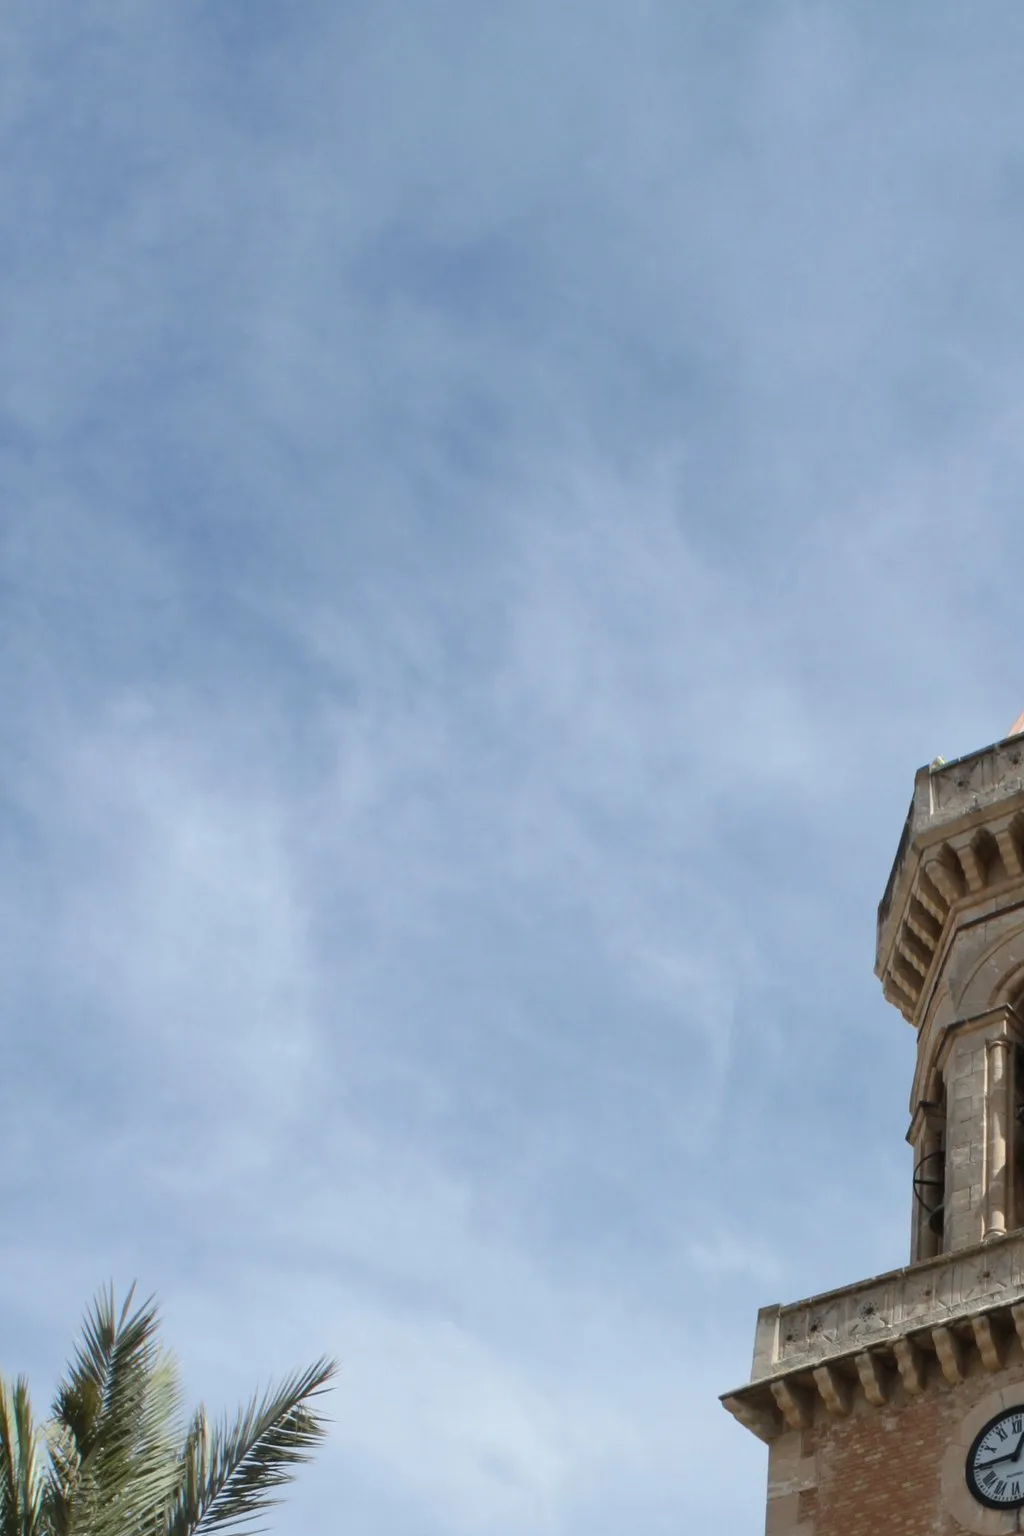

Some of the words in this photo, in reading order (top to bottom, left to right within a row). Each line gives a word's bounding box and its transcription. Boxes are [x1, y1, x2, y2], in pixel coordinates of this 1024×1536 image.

[996, 1425, 1008, 1442] XI
[1012, 1420, 1022, 1434] XII
[984, 1445, 997, 1453] X
[983, 1471, 998, 1489] VIII
[994, 1481, 1007, 1496] VII
[1012, 1481, 1020, 1496] VI
